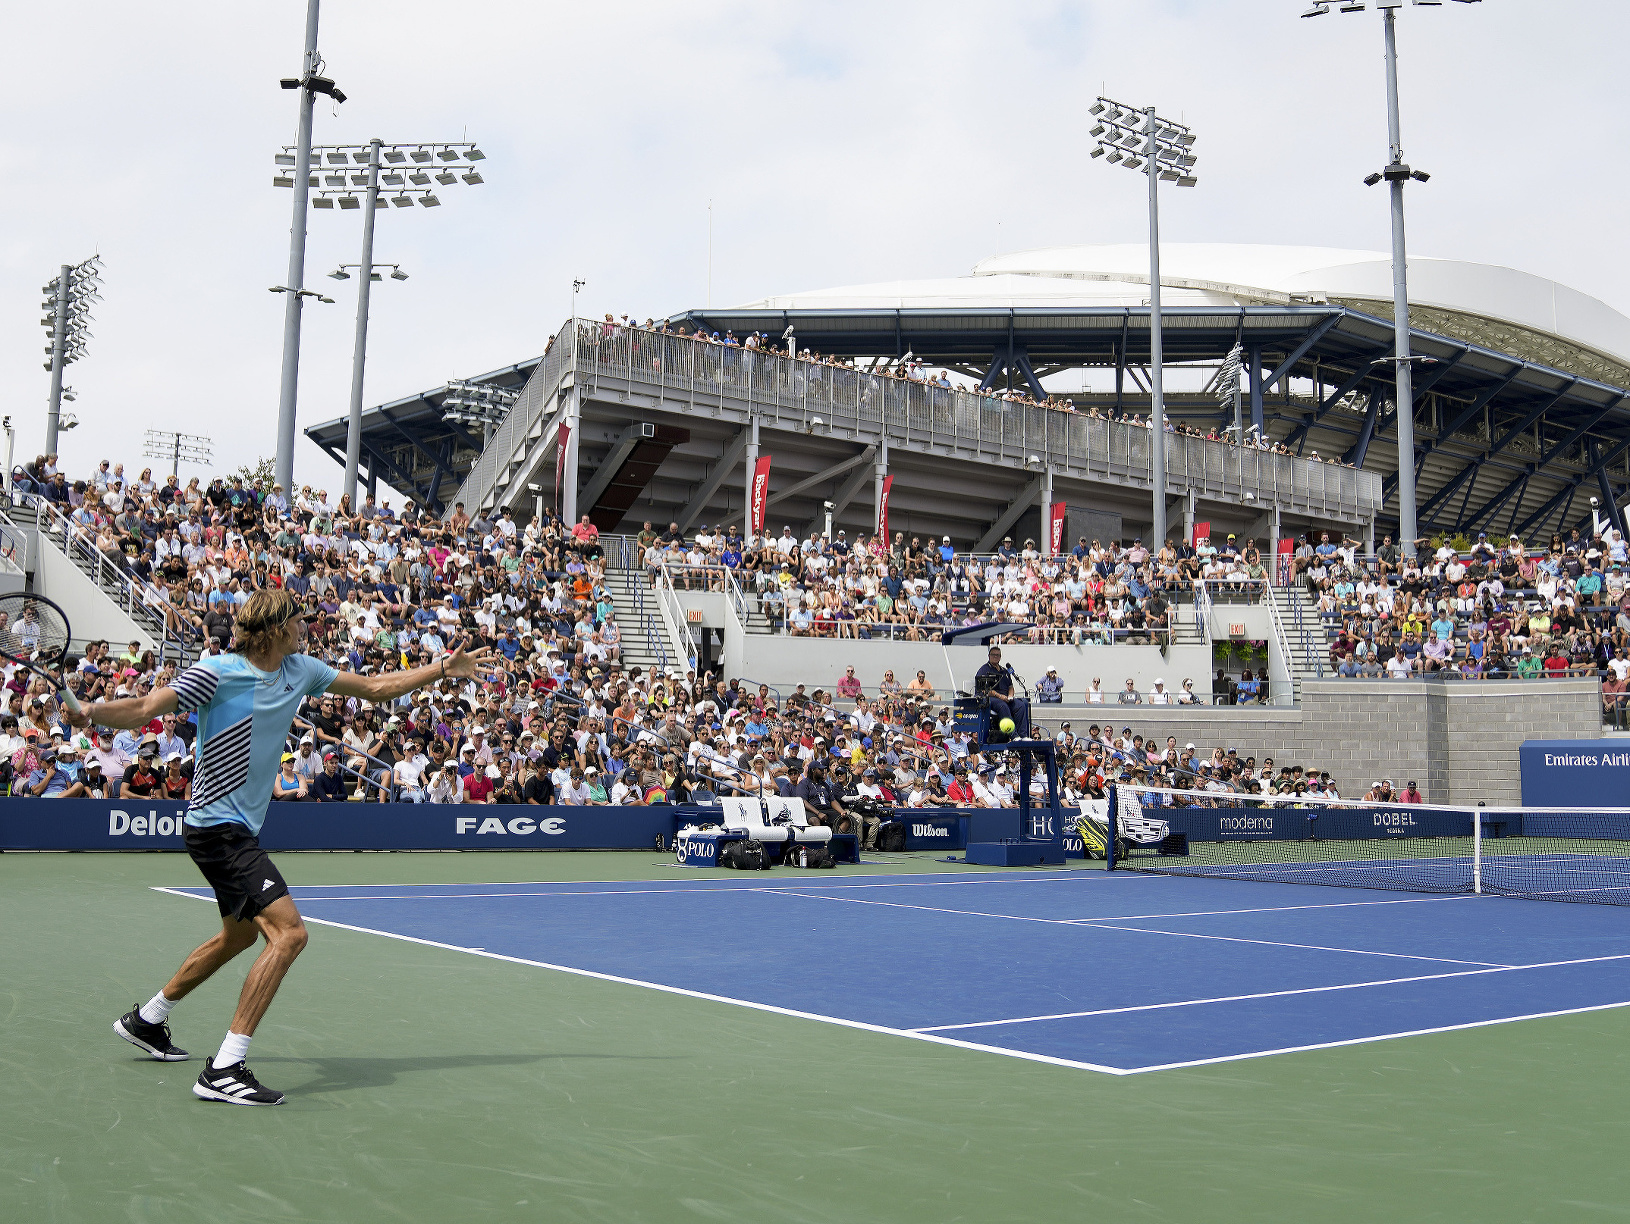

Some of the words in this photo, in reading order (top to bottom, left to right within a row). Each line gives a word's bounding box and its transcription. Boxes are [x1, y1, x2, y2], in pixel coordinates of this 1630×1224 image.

[753, 474, 766, 529] backyar
[689, 611, 702, 621] EXIT
[1231, 624, 1244, 634] EXIT
[1545, 753, 1598, 766] Emirates
[1601, 753, 1630, 766] Airli
[109, 810, 187, 836] Deloi
[456, 817, 567, 835] FAGE
[1220, 814, 1273, 830] moderna
[1373, 812, 1416, 826] DOBEL
[687, 841, 715, 858] POLO
[1062, 838, 1083, 852] OLO
